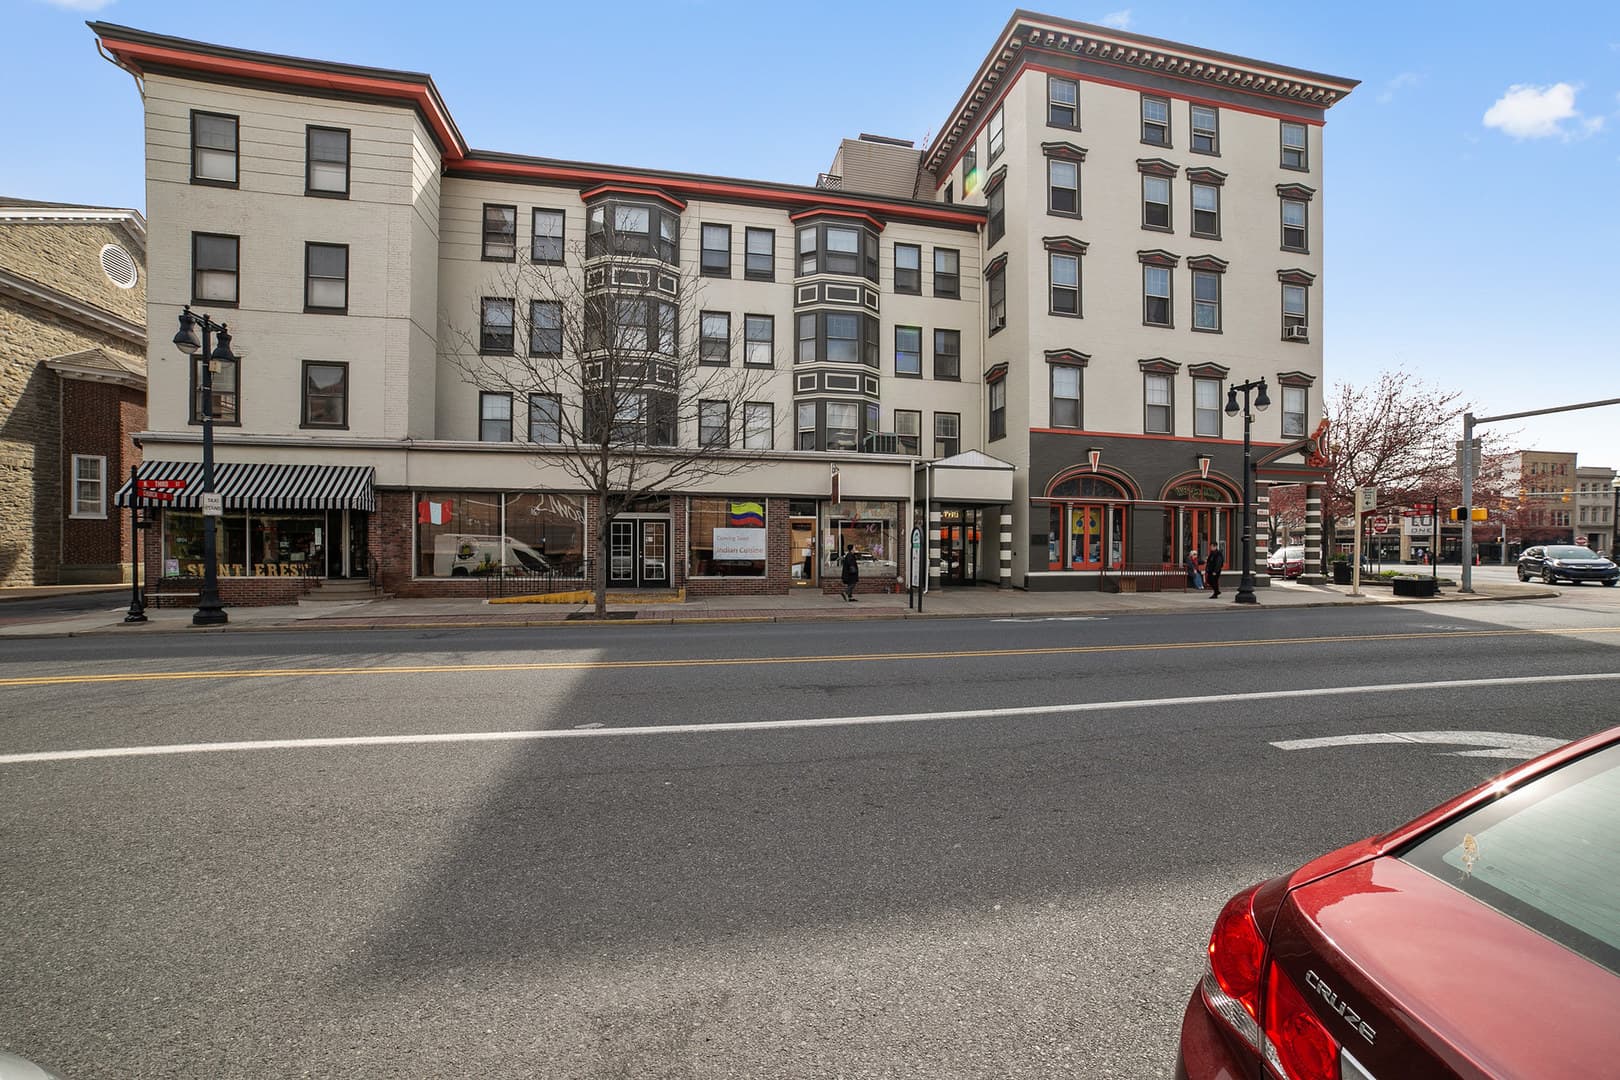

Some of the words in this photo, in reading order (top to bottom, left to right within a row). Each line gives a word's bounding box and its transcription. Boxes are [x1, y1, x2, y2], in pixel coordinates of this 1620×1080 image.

[716, 545, 738, 554] Indian
[739, 546, 764, 554] Cuisine
[1305, 969, 1377, 1046] CRUZE
